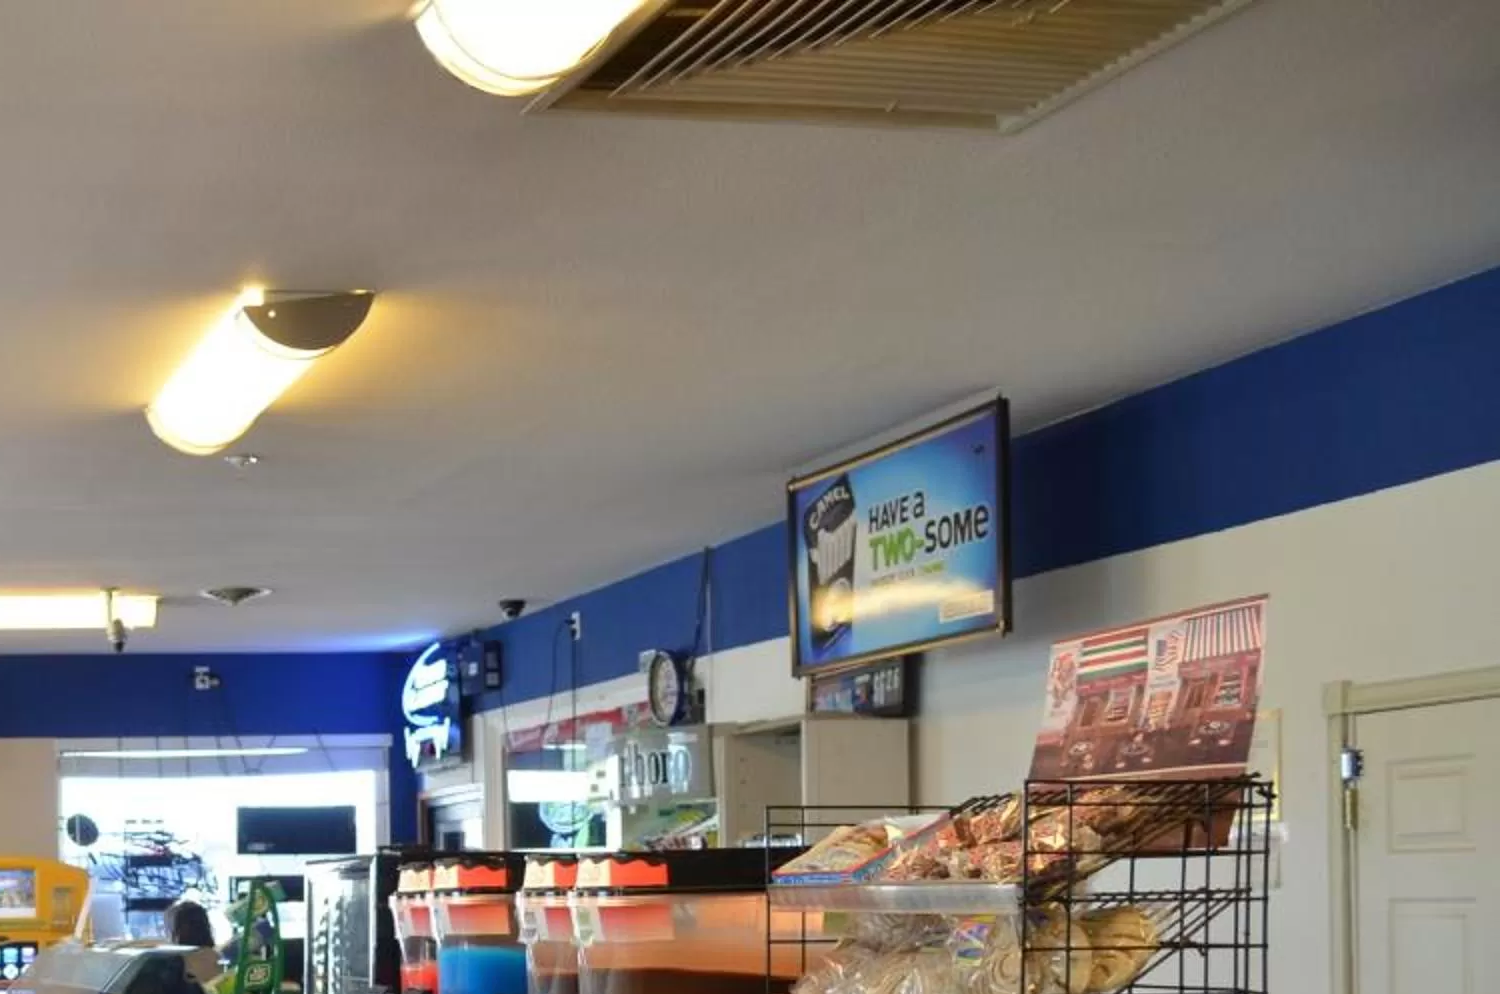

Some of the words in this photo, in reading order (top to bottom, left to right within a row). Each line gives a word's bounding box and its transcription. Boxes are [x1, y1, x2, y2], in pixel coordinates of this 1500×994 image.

[809, 485, 850, 530] CAMEL
[868, 494, 910, 534] HAVE
[912, 491, 926, 518] a
